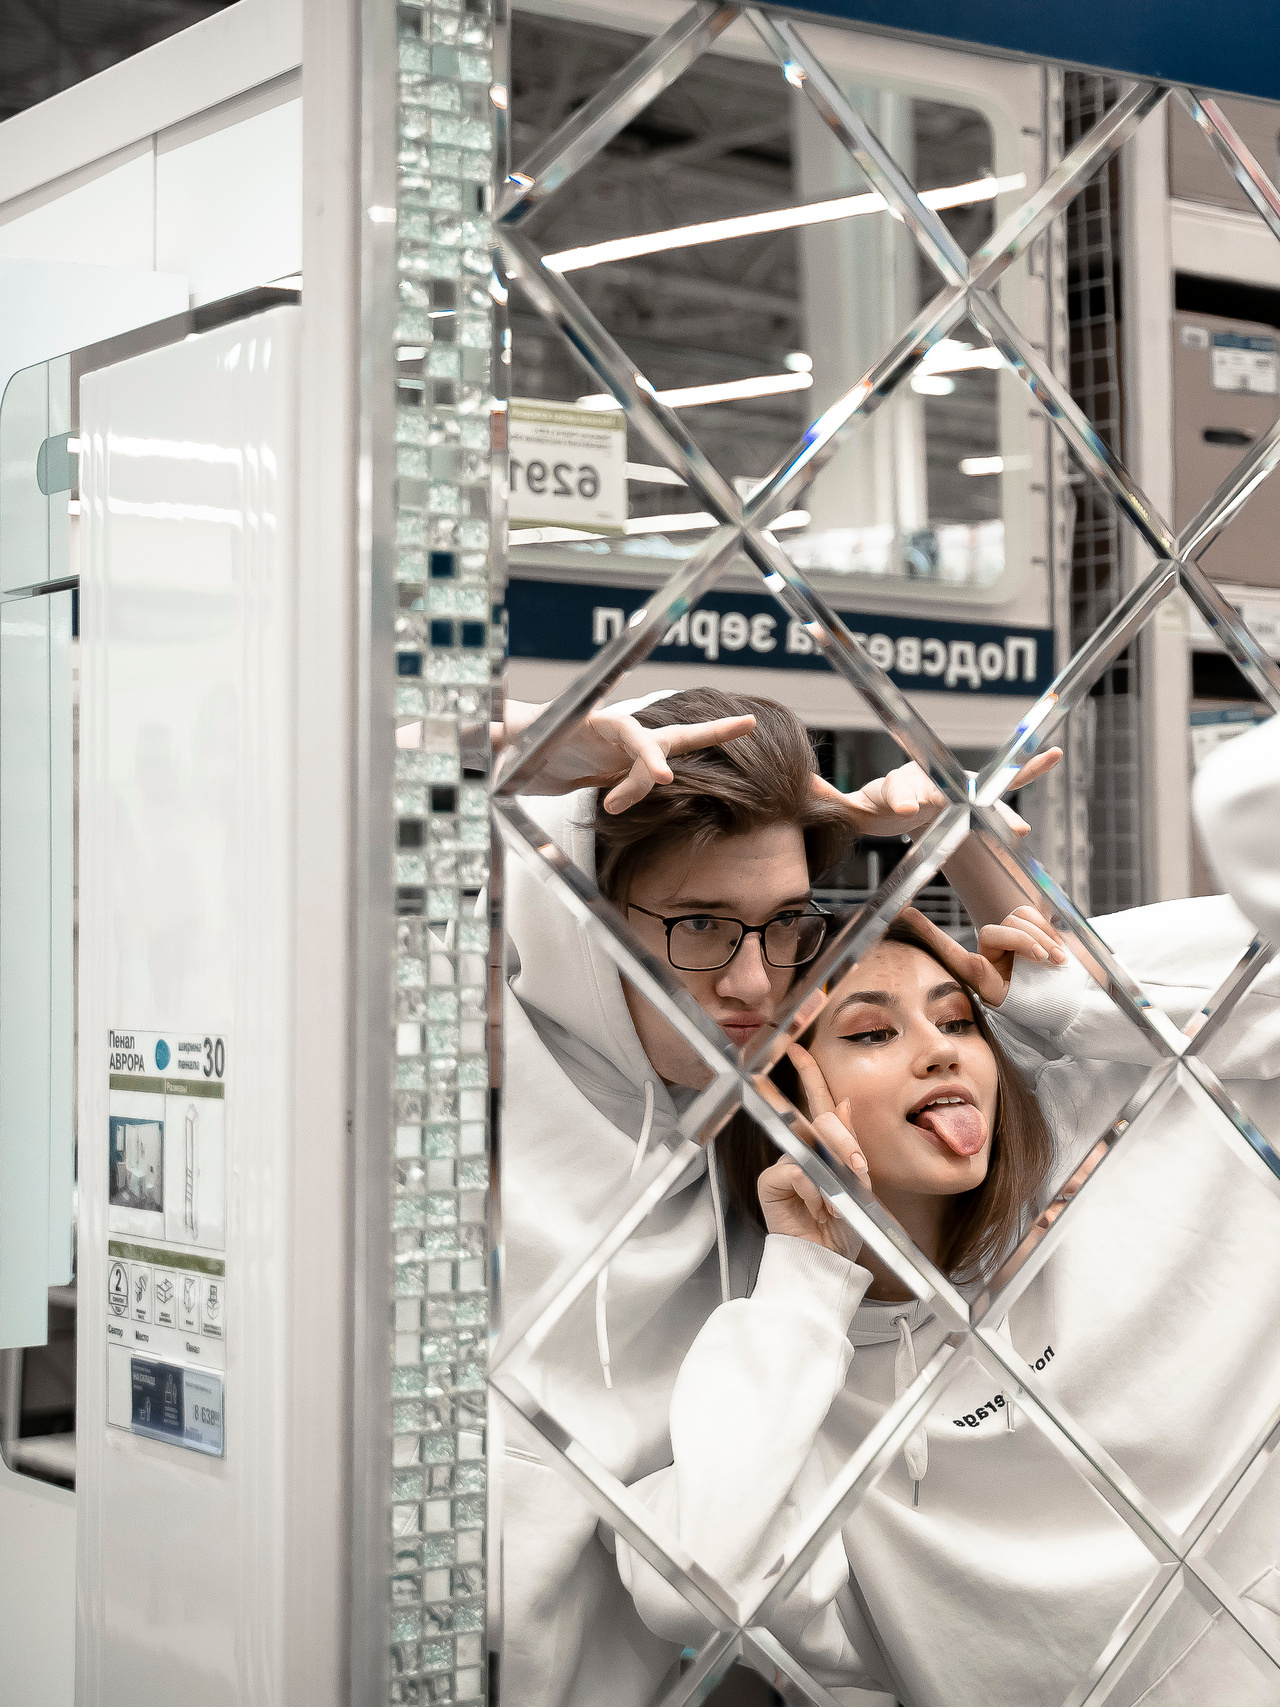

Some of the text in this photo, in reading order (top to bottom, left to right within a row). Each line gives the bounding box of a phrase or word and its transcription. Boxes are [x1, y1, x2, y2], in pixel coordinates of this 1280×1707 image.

[109, 1031, 134, 1049] Пенал
[109, 1053, 145, 1071] АВРОРА
[203, 1037, 224, 1077] 30
[115, 1268, 122, 1292] 2
